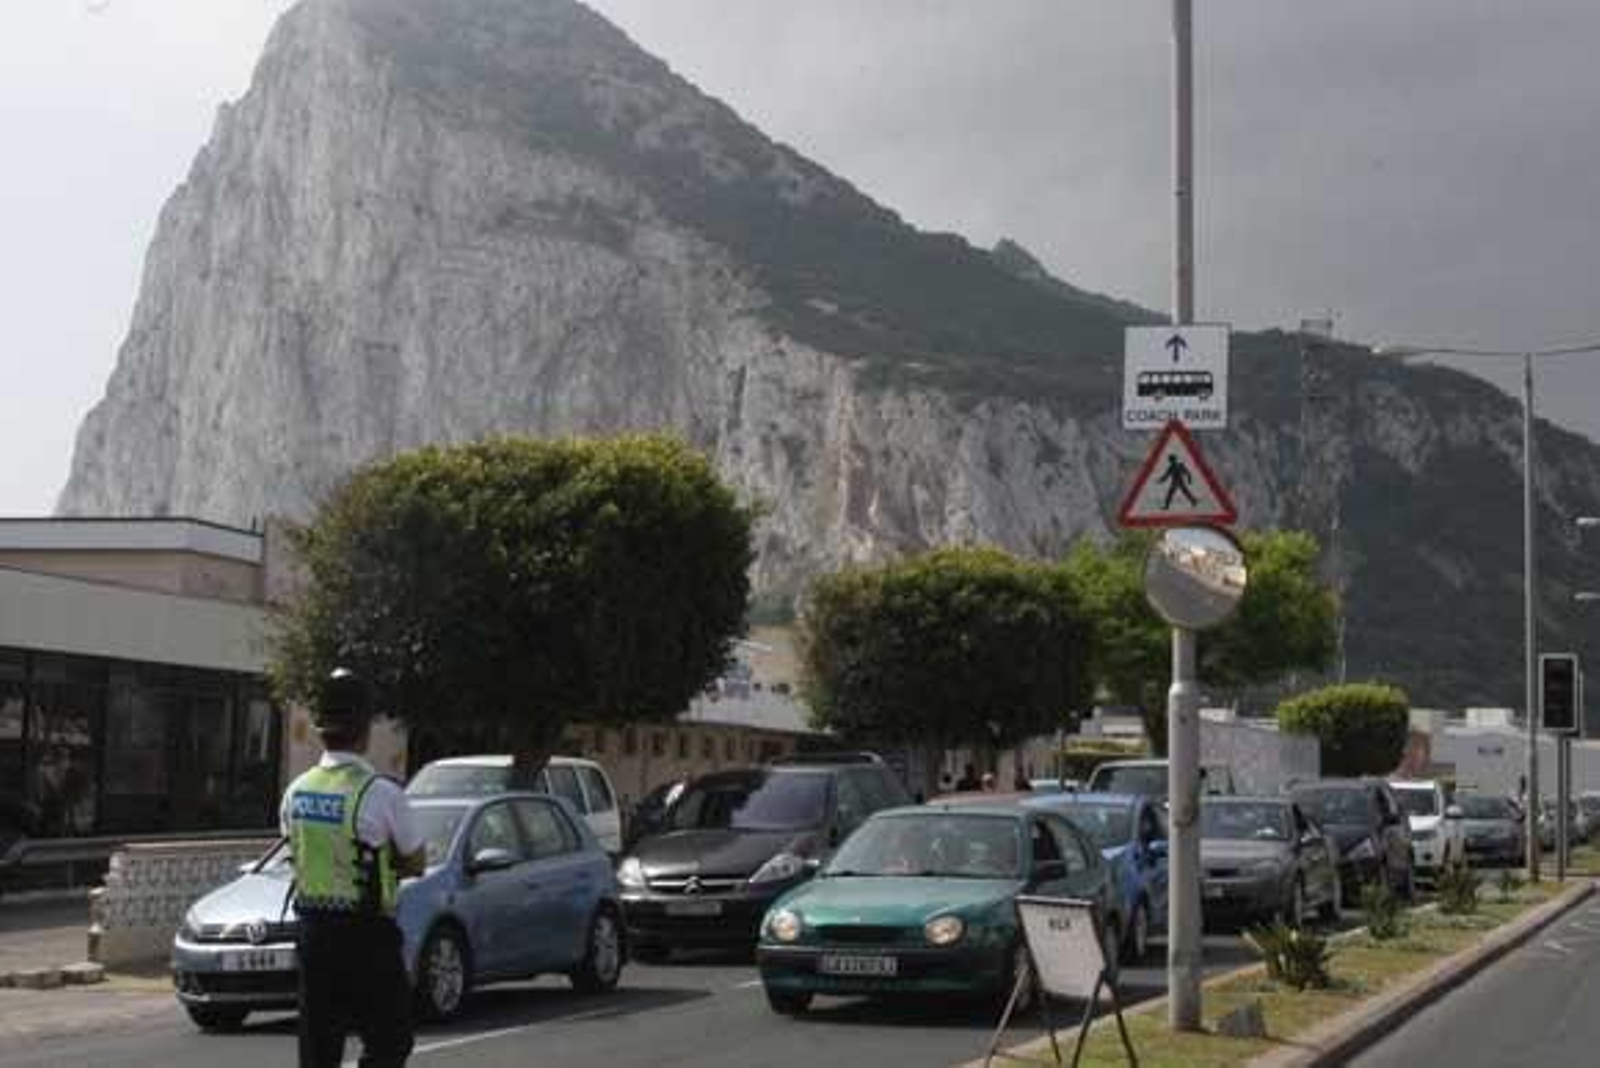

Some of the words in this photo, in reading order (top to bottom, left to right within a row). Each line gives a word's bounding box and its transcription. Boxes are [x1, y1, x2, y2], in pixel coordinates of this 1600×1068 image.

[1126, 409, 1178, 422] COACH
[1183, 409, 1220, 421] PARK
[293, 796, 342, 818] POLICE
